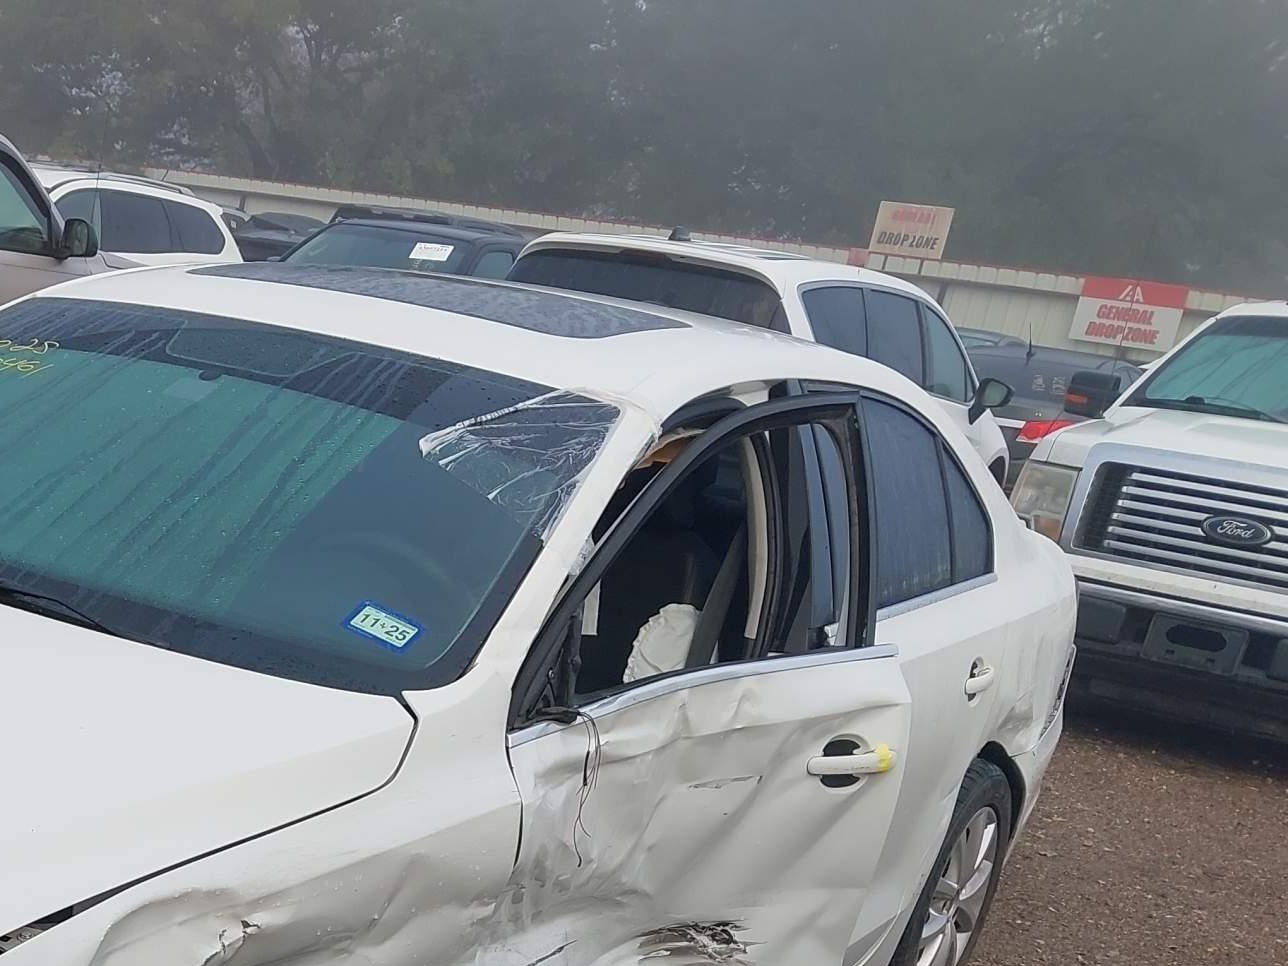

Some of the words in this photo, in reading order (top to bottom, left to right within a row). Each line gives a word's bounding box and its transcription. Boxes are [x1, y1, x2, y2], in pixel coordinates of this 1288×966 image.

[877, 231, 910, 249] DROP
[909, 234, 940, 250] ZONE
[1096, 303, 1155, 326] GENERAL
[1085, 321, 1124, 340] DROP
[1122, 326, 1160, 345] ZONE
[1216, 520, 1257, 538] Ford
